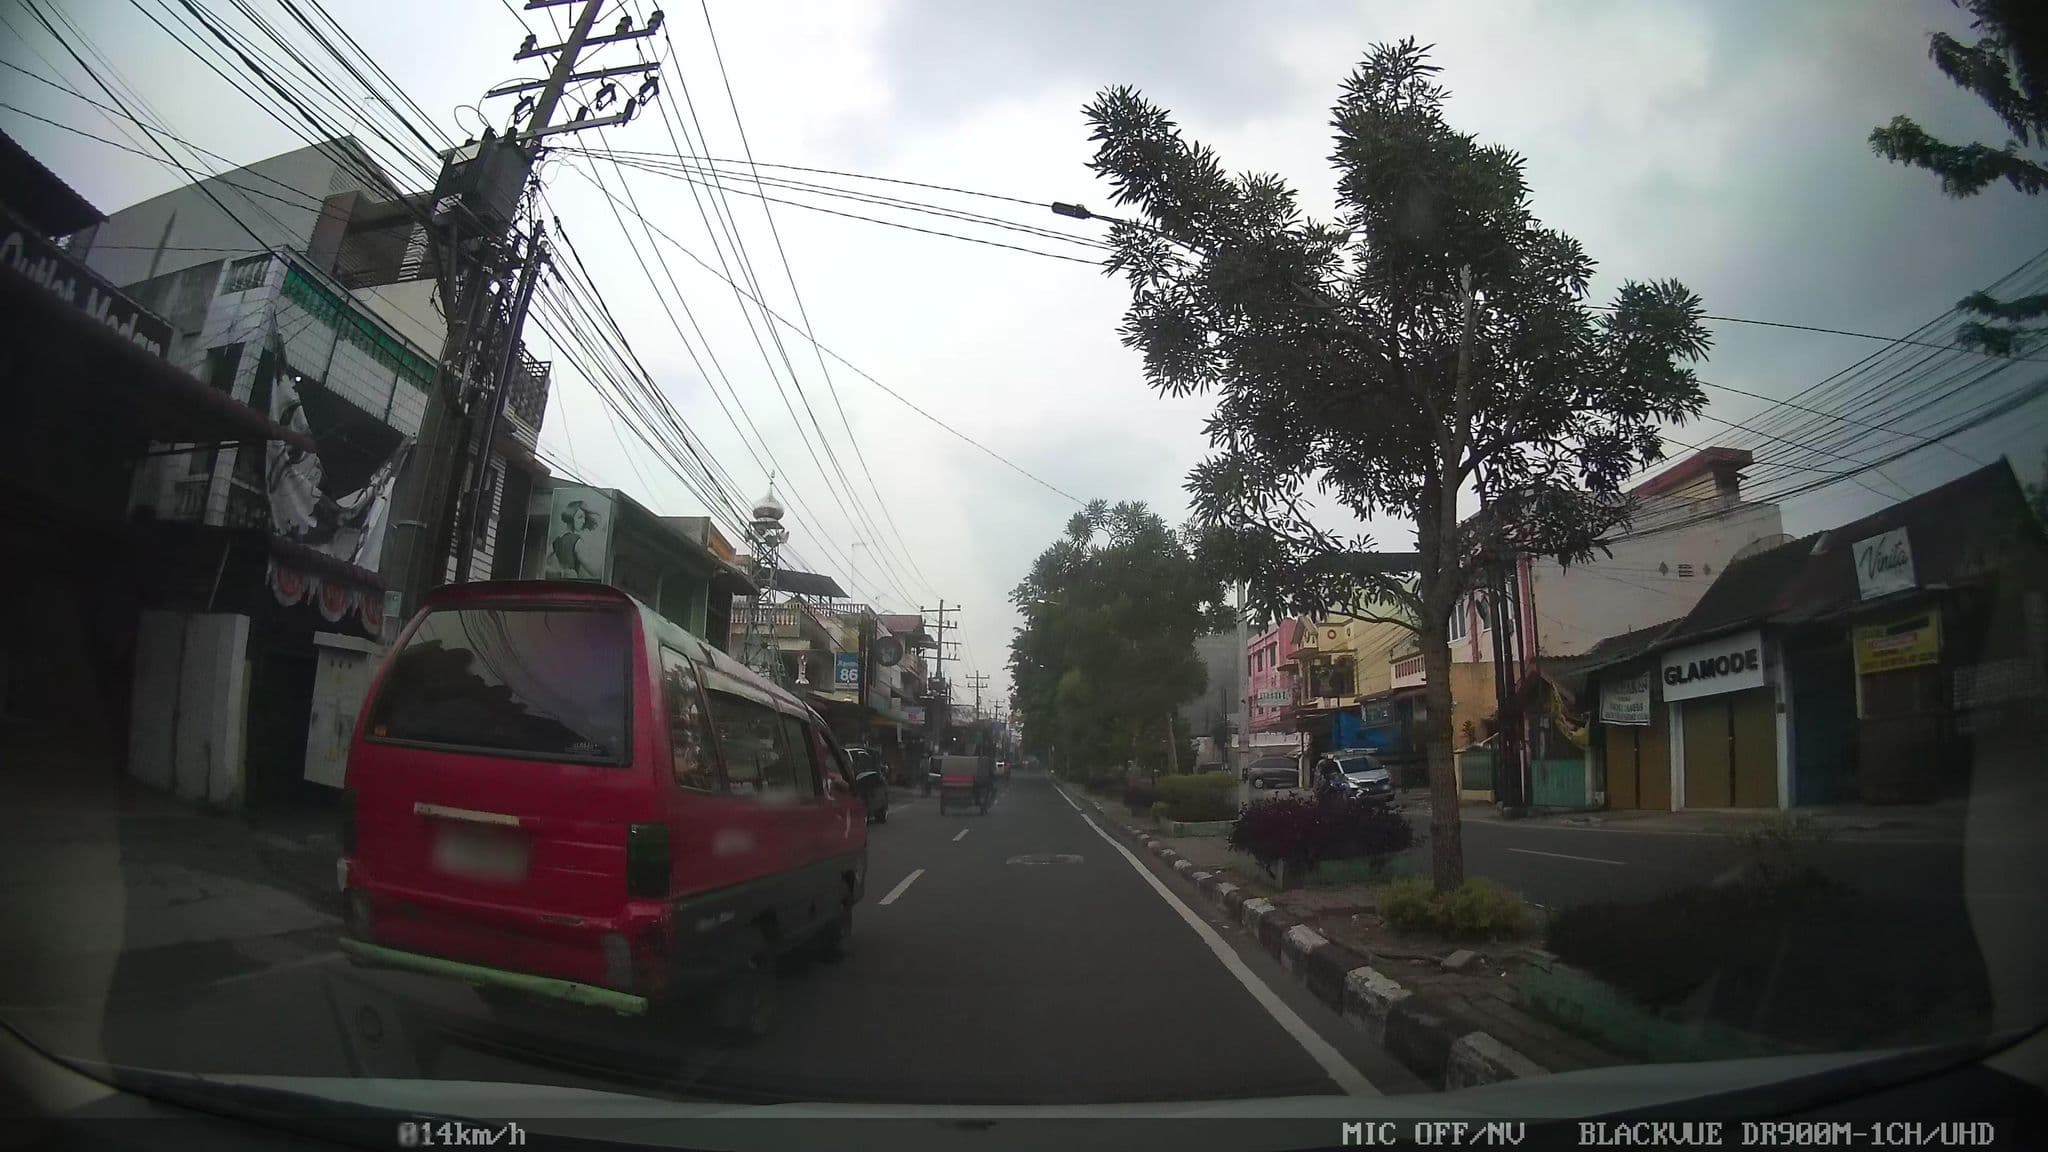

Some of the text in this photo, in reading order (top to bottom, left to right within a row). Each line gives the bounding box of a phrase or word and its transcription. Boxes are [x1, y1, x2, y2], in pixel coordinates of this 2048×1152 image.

[1859, 536, 1910, 579] Vinita
[840, 668, 858, 681] 86
[1664, 649, 1759, 686] GLAMODE
